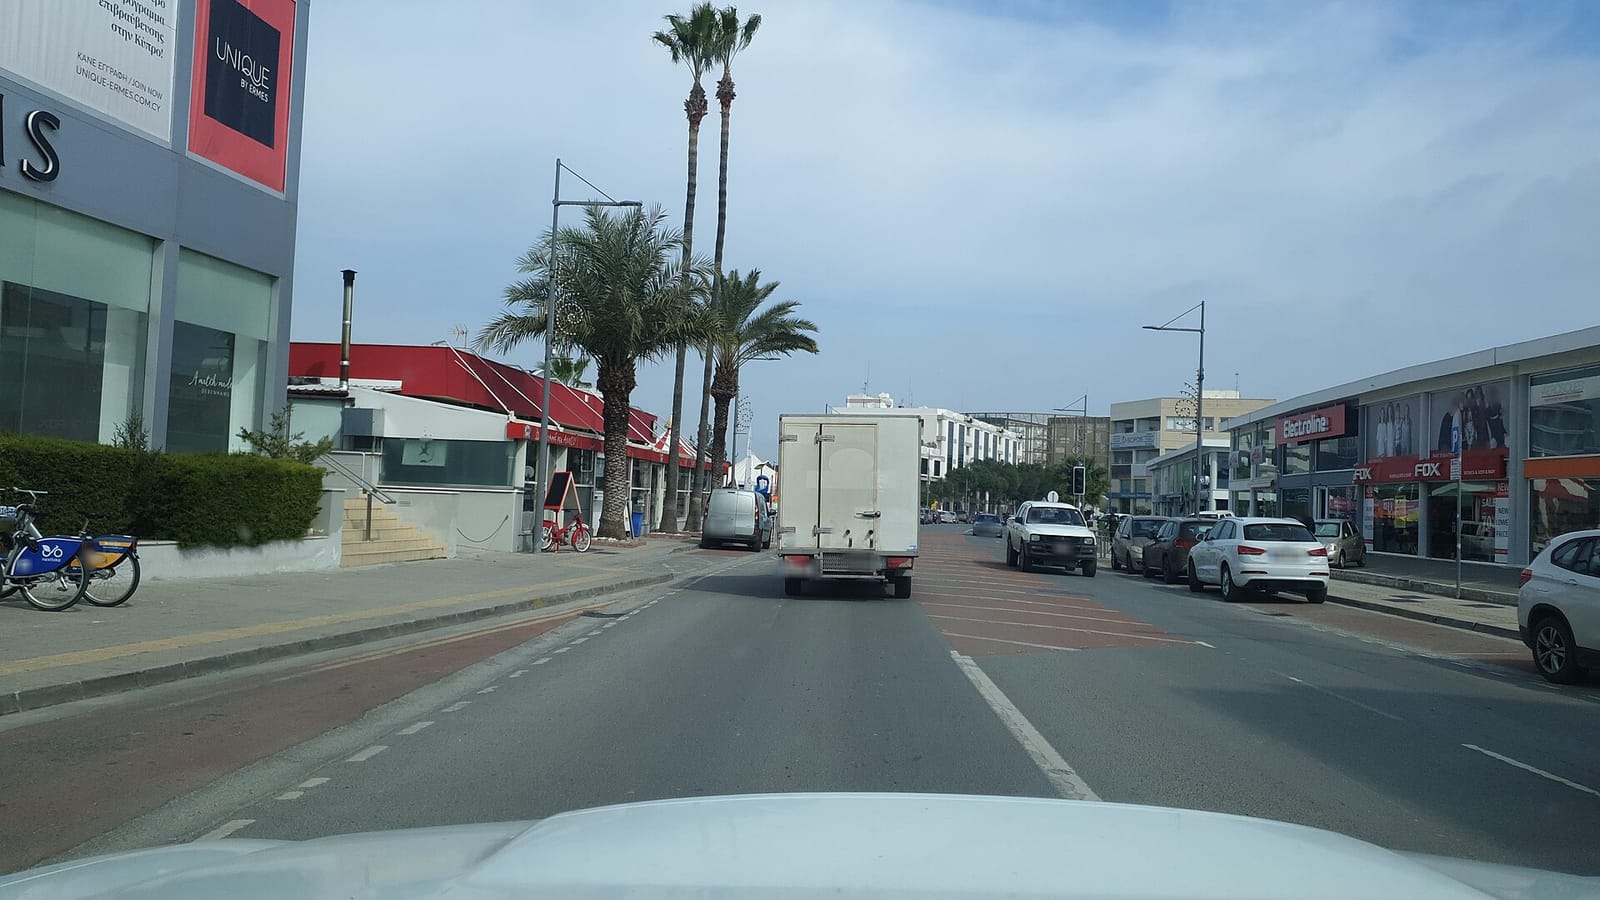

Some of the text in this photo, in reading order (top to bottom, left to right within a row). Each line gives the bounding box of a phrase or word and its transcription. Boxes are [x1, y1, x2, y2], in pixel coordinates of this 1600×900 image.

[216, 36, 270, 90] UNIQUE
[240, 78, 269, 103] BY ERMES
[1284, 414, 1328, 438] Electroline
[1353, 467, 1372, 480] FOX
[1414, 462, 1441, 477] FOX
